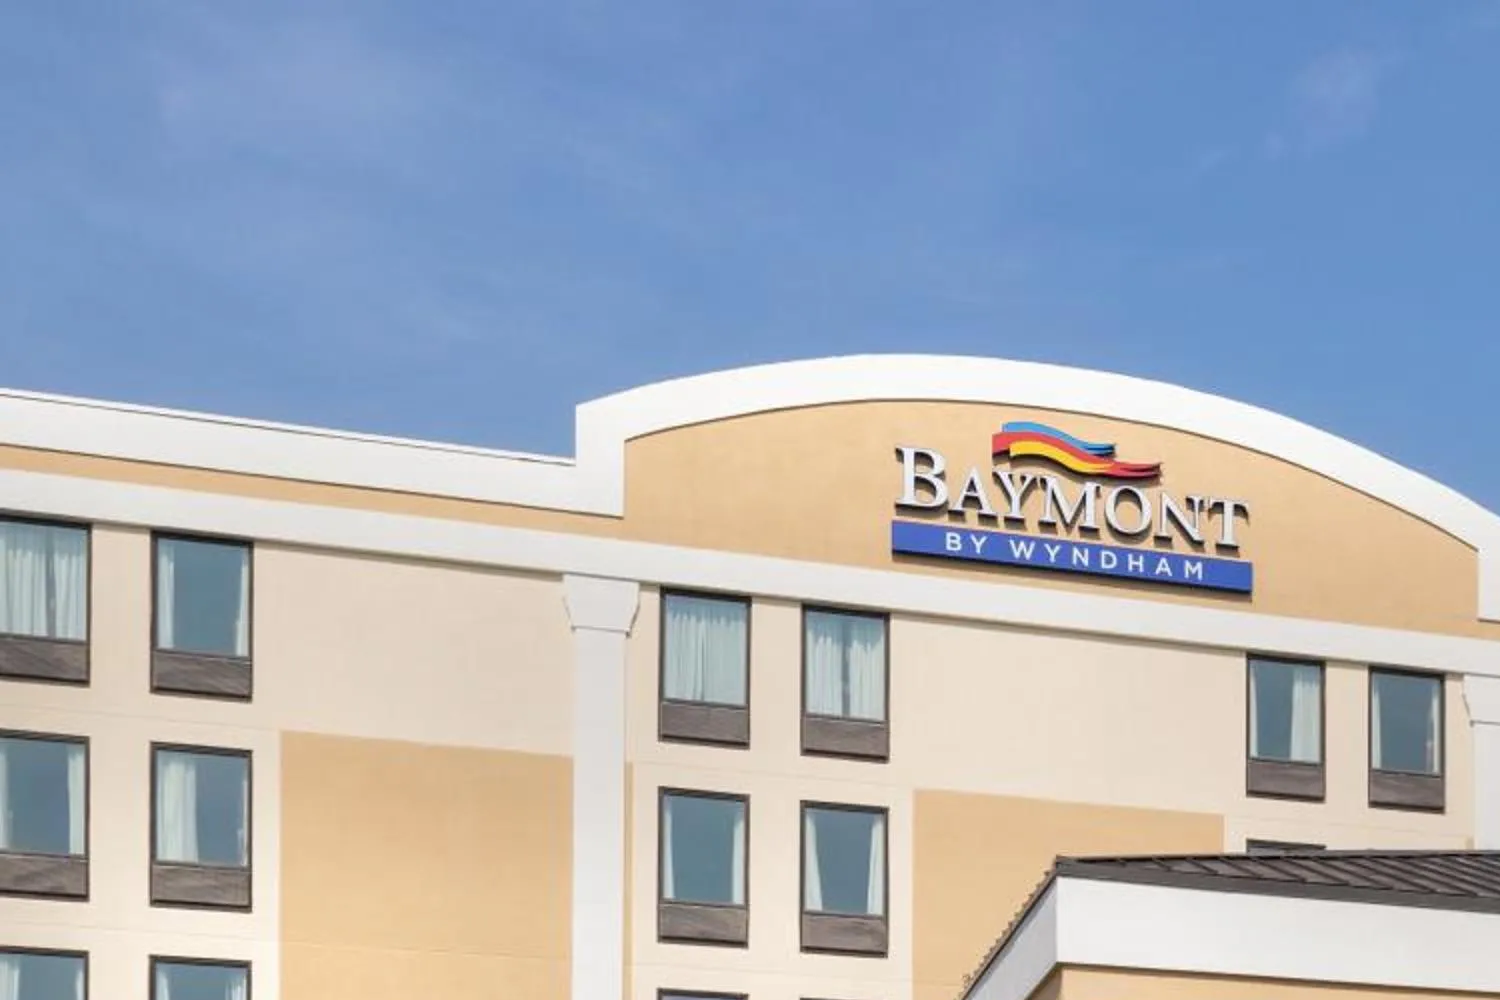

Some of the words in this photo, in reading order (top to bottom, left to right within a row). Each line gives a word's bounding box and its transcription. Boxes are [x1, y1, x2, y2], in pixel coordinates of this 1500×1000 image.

[895, 446, 1250, 547] BAYMONT
[945, 532, 987, 555] BY
[1009, 539, 1204, 581] WYNDHAM
